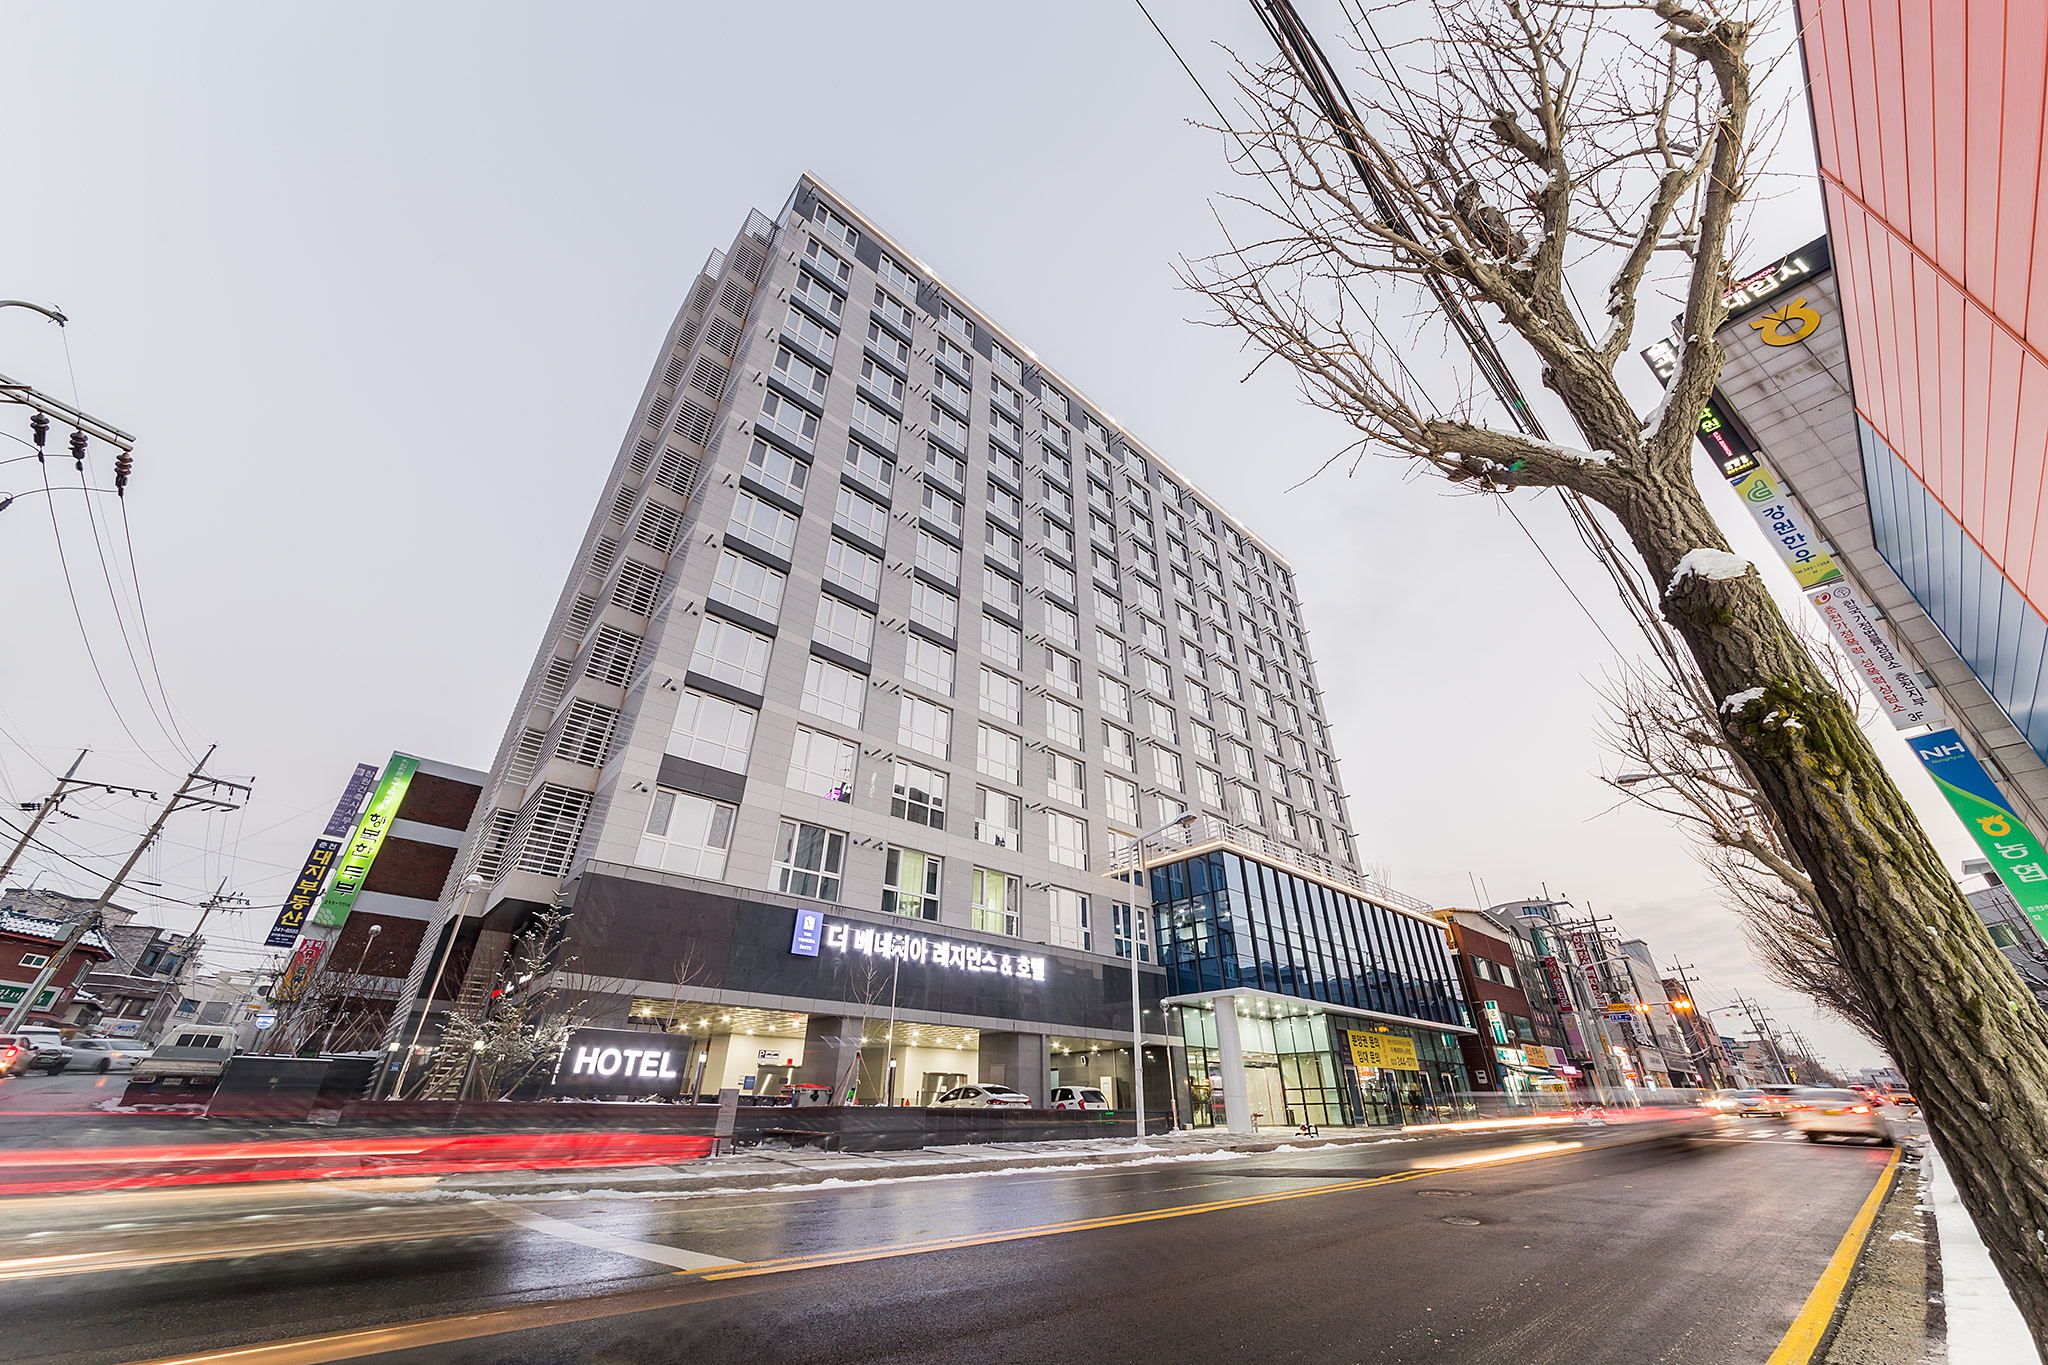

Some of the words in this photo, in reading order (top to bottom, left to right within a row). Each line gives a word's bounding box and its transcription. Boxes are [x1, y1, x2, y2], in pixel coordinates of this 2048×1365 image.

[1762, 504, 1817, 564] 강원한우
[1894, 671, 1928, 707] 춘천지부
[1907, 711, 1924, 722] 3F
[1919, 741, 1966, 761] NH
[351, 812, 387, 860] 행복한
[333, 864, 365, 897] 두부
[1993, 842, 2048, 884] 농협
[280, 849, 334, 927] 대지부동산
[827, 924, 850, 953] 더
[854, 928, 929, 965] 베네치아
[932, 941, 998, 973] 레지던스
[1000, 954, 1013, 976] &
[1016, 955, 1046, 982] 호텔
[572, 1046, 677, 1079] HOTEL
